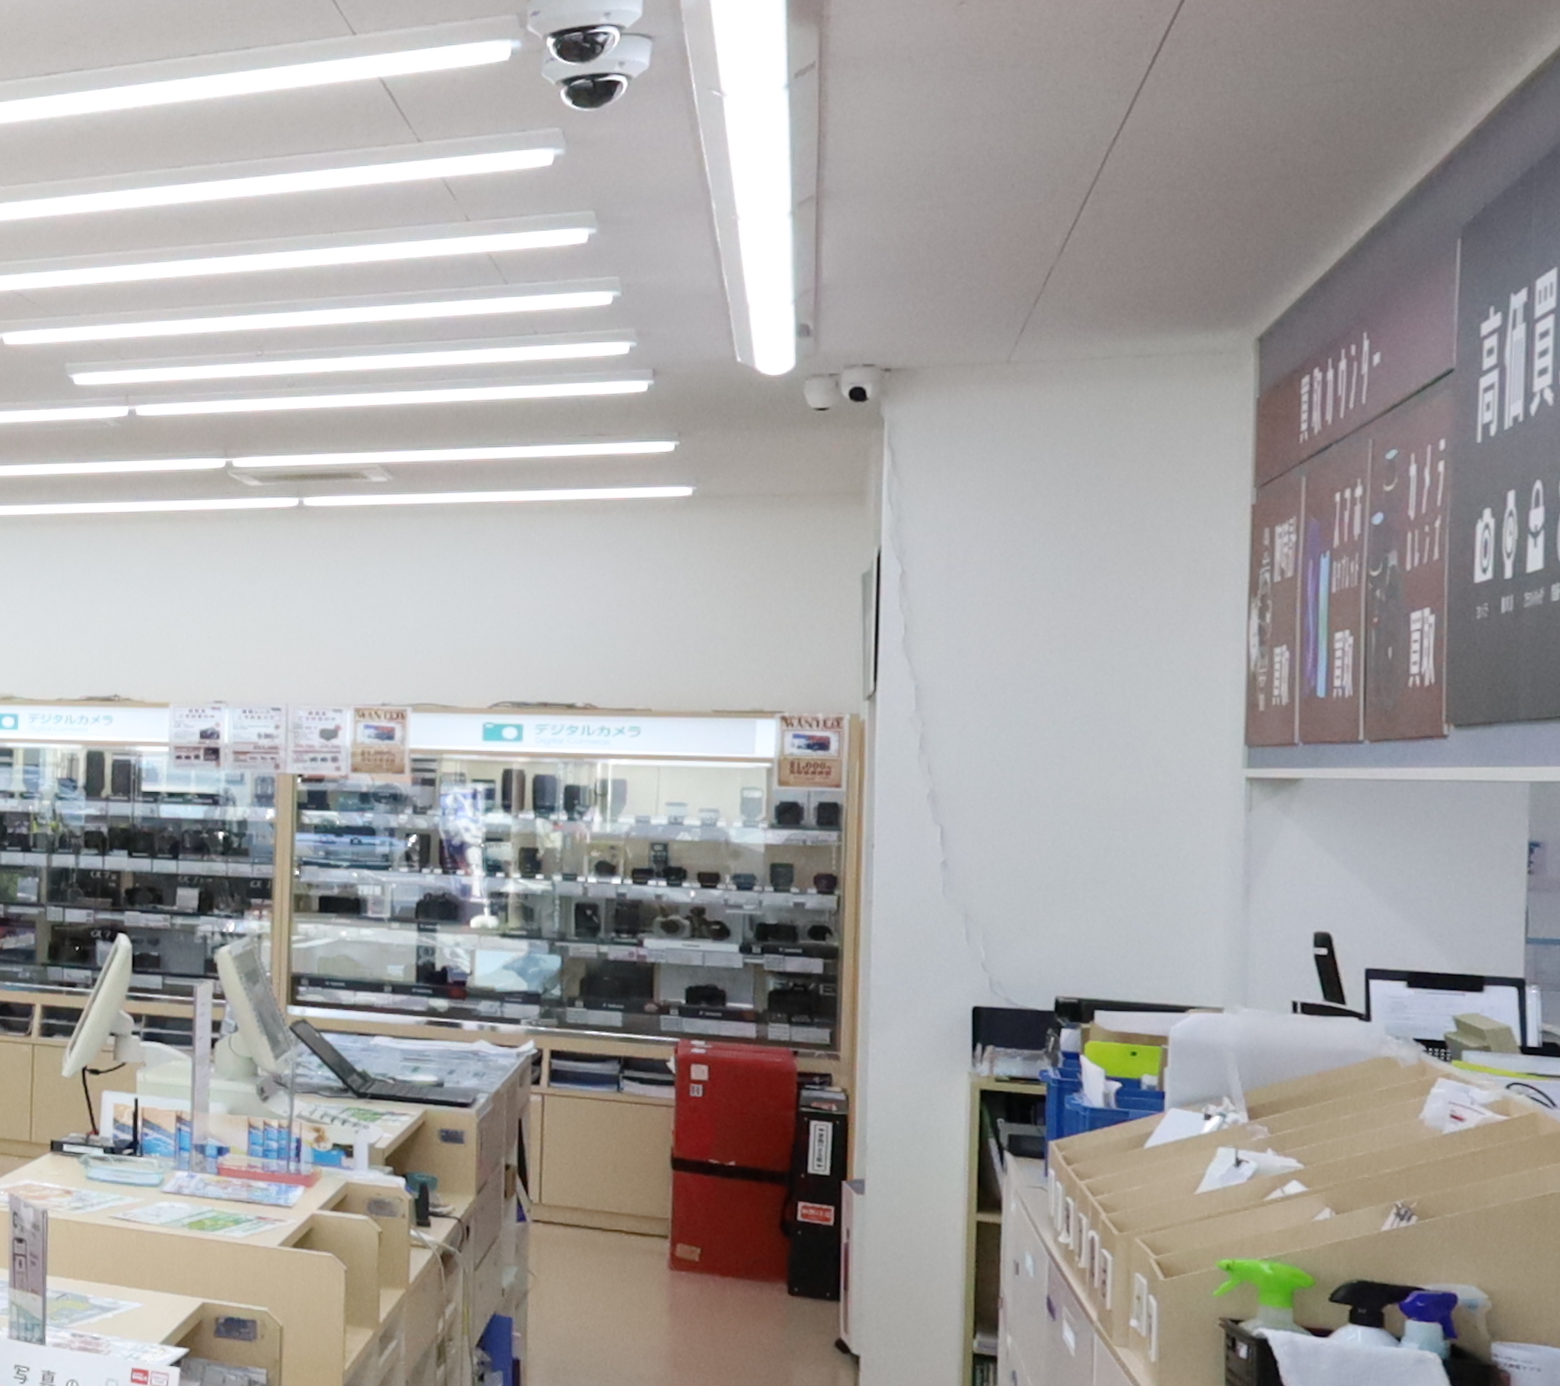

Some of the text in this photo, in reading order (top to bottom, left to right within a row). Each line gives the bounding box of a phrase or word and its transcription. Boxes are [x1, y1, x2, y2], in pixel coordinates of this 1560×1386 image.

[1300, 332, 1381, 444] 買取カウンター
[1476, 267, 1560, 444] 高価買
[1333, 478, 1363, 549] スマホ
[1407, 438, 1446, 521] カメラ
[1333, 629, 1355, 699] 買取
[1409, 607, 1436, 688] 買取
[28, 713, 114, 727] デジタルカメラ
[534, 723, 642, 739] デジタルカメラ
